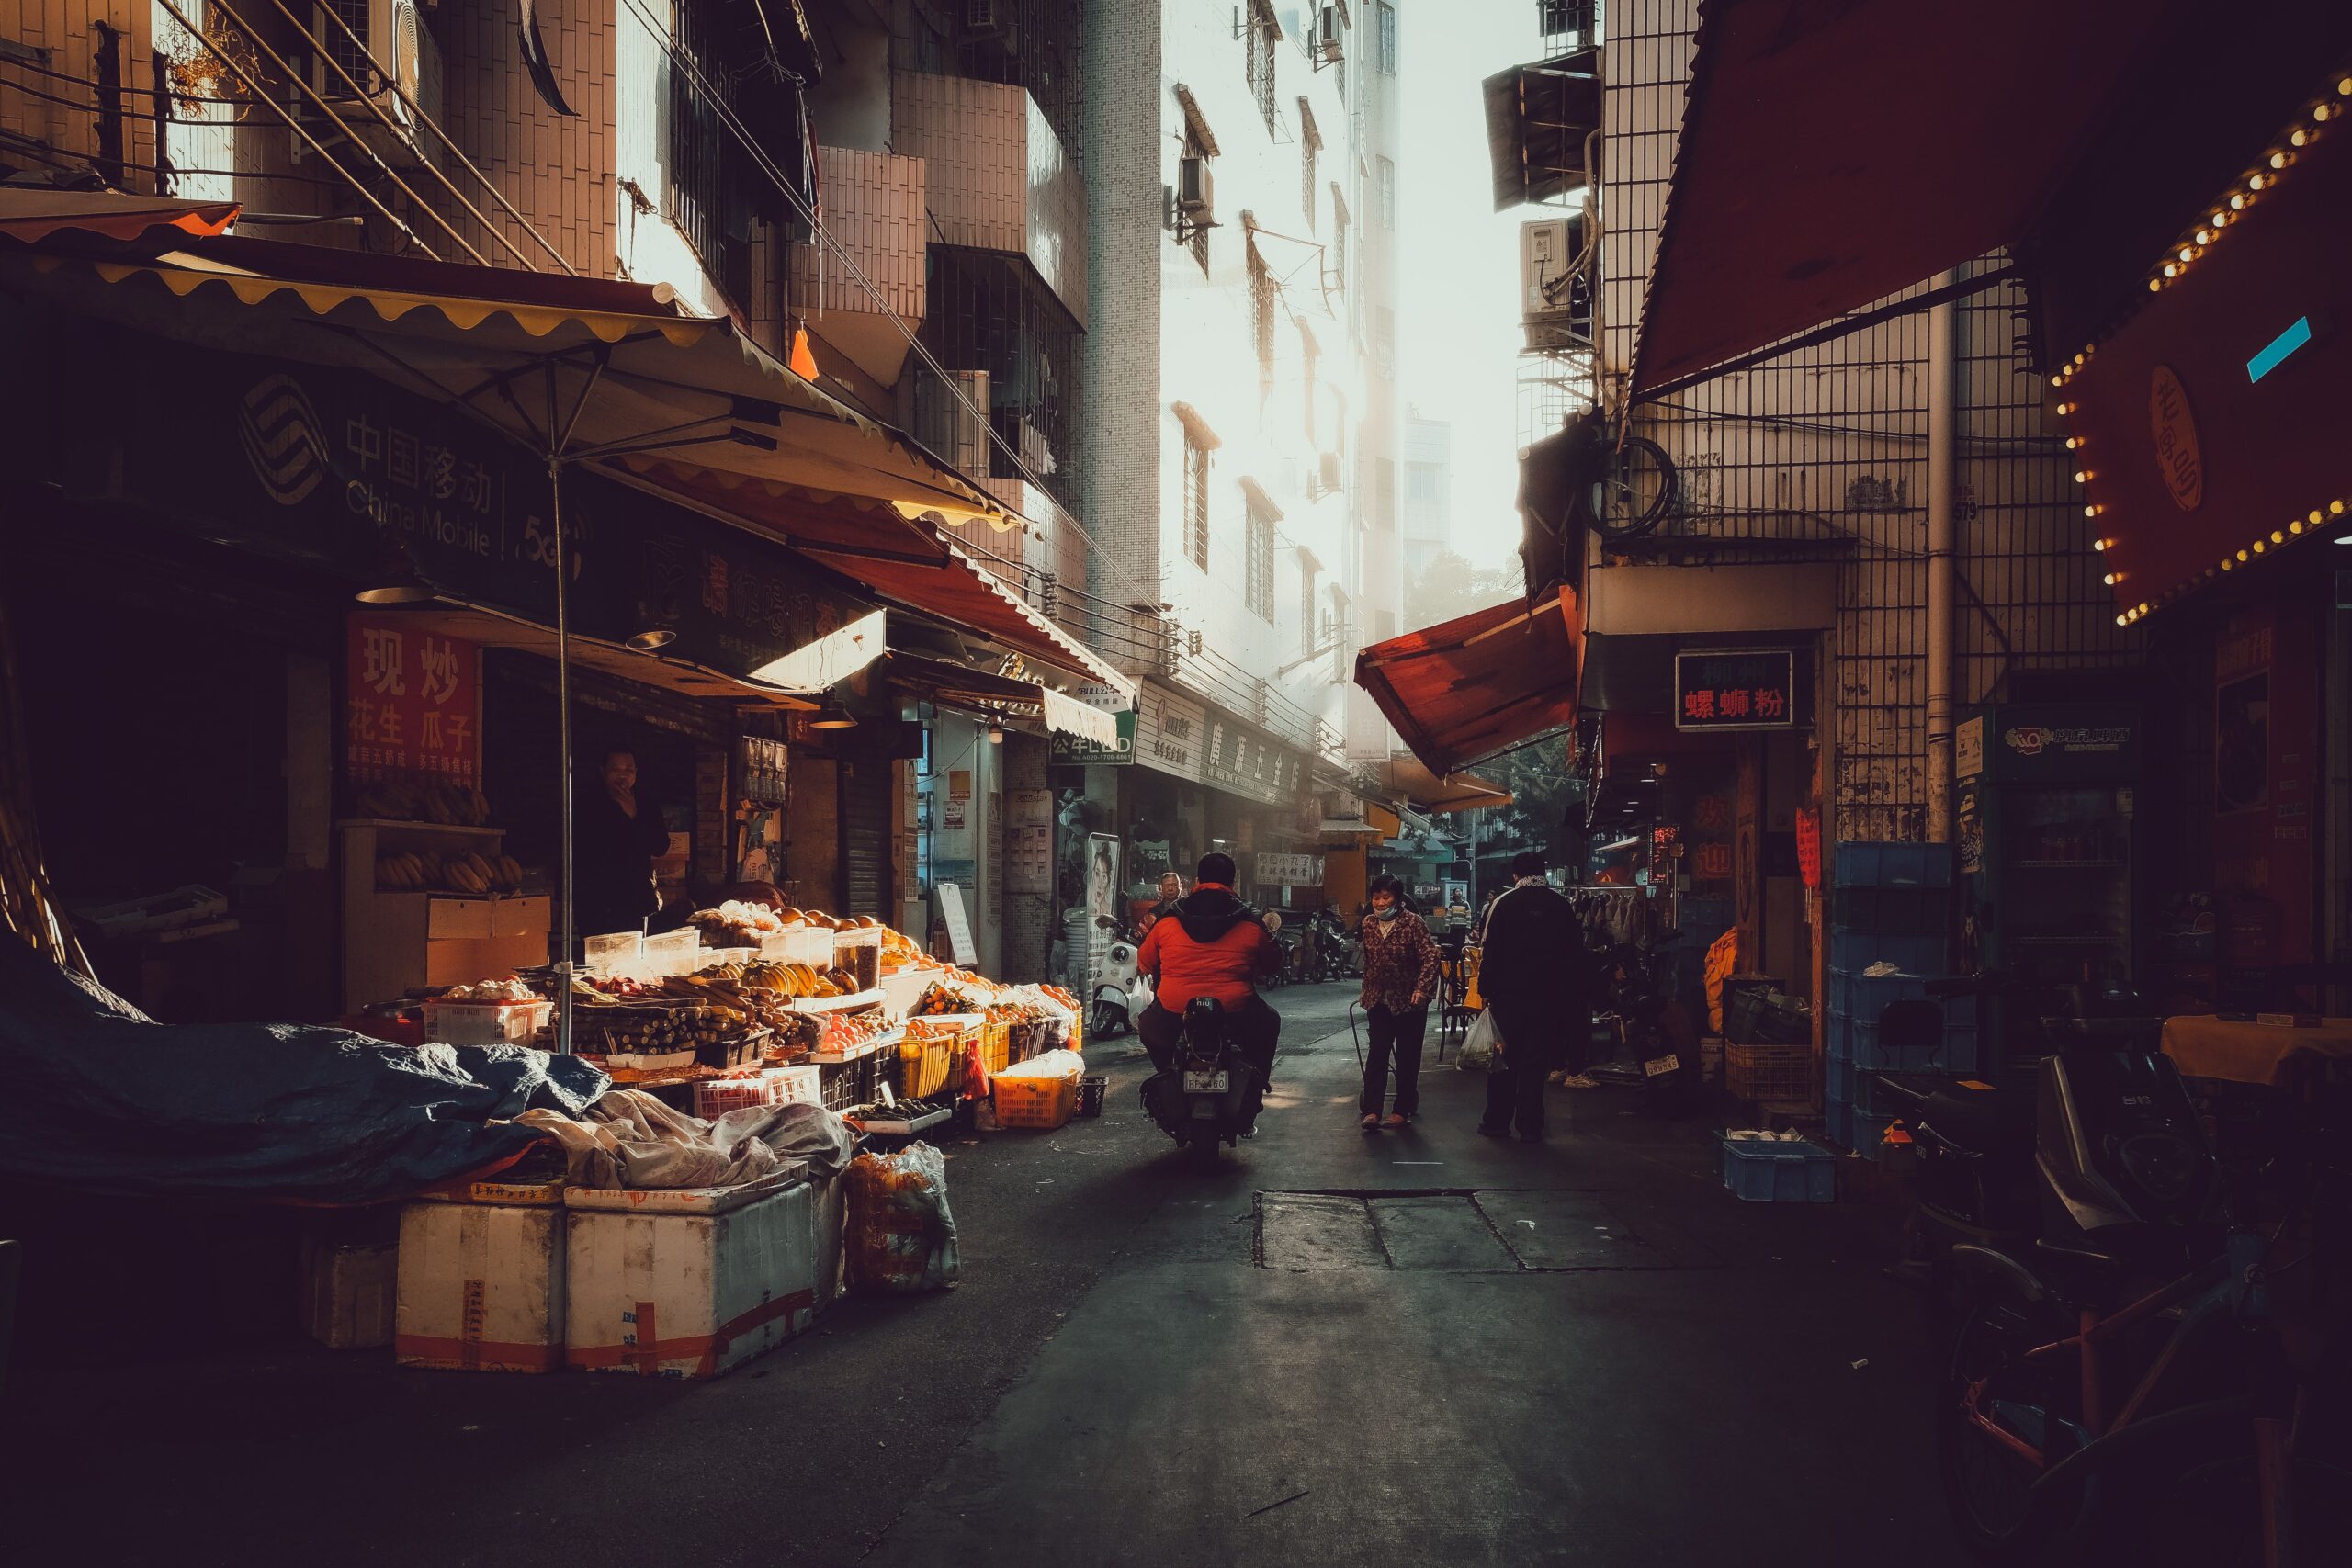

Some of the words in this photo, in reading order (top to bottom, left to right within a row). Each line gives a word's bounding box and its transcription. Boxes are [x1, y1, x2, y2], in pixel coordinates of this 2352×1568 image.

[346, 412, 492, 514] 中国移动
[345, 479, 414, 533] China
[422, 505, 491, 558] Mobile
[1685, 689, 1783, 719] 螺蛳粉
[1702, 660, 1766, 684] 柳州
[1209, 722, 1300, 794] 廣源五金店
[1697, 794, 1732, 879] 欢迎
